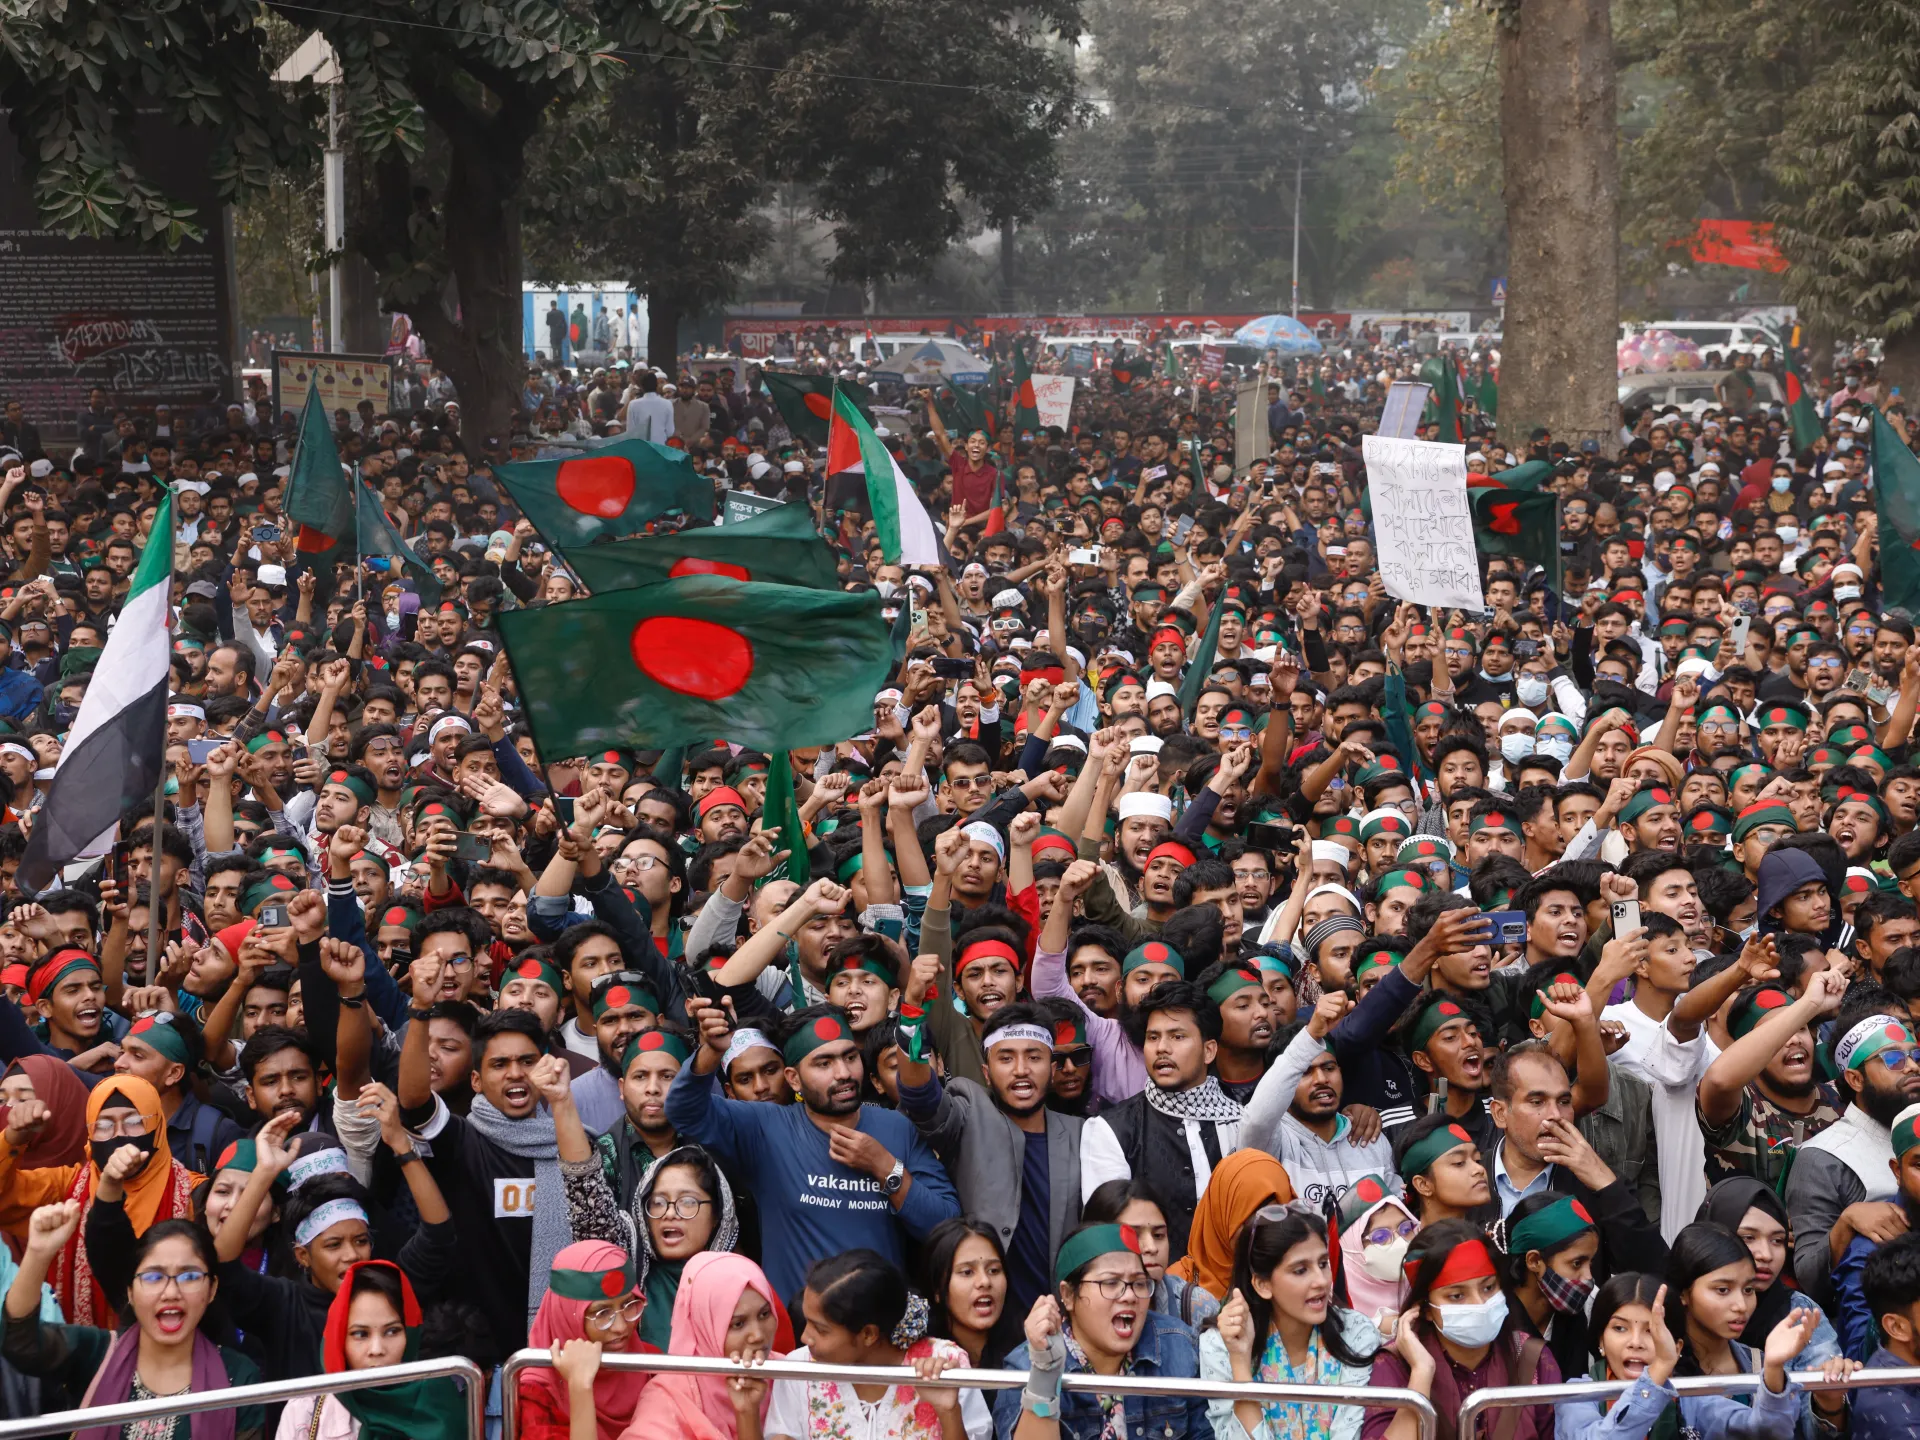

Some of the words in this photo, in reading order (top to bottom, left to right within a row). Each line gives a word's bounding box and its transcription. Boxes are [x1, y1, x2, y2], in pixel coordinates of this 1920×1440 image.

[807, 1173, 881, 1193] vakantie
[799, 1193, 843, 1209] MONDAY
[848, 1199, 889, 1210] MONDAY
